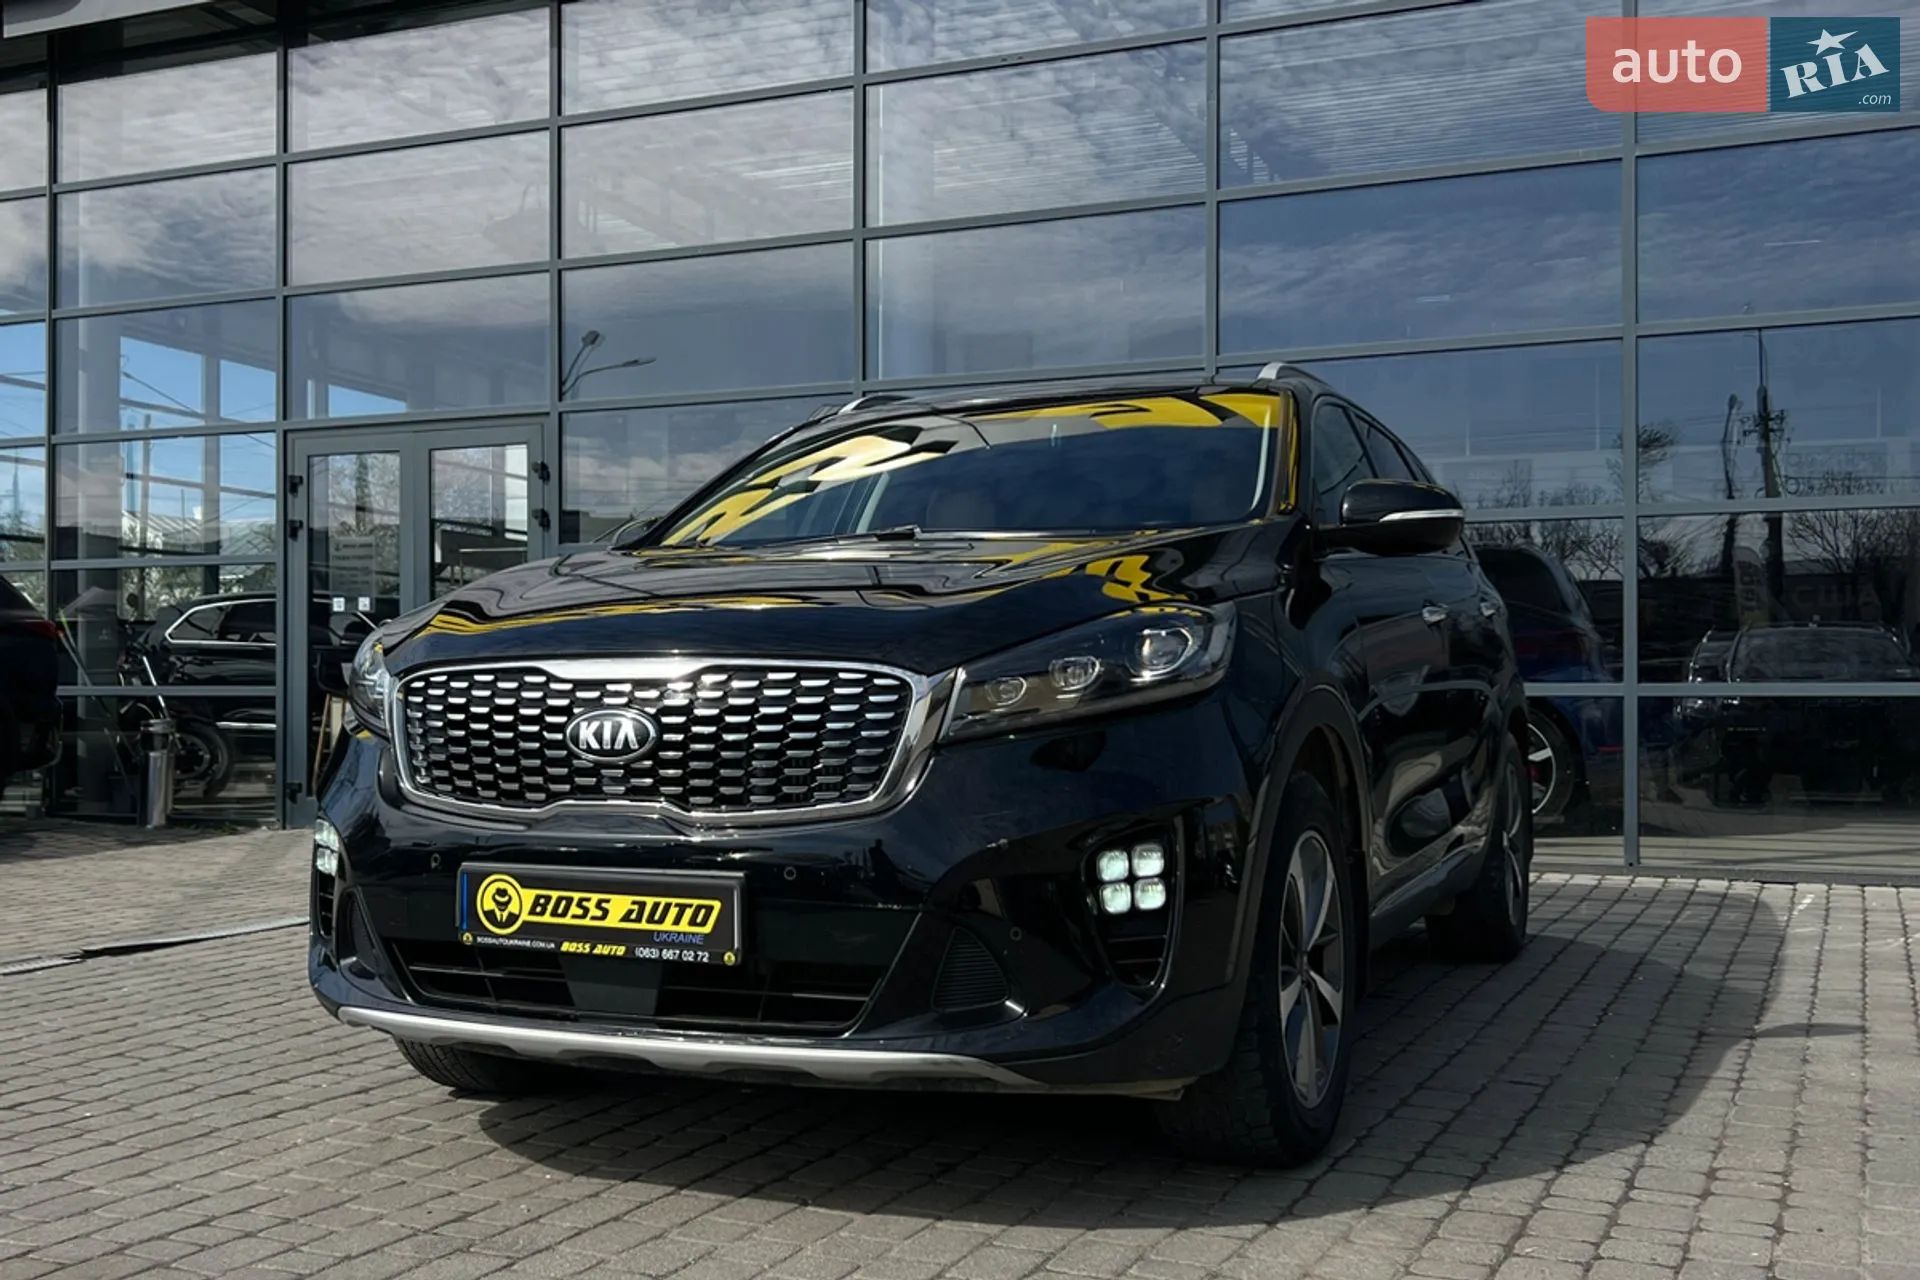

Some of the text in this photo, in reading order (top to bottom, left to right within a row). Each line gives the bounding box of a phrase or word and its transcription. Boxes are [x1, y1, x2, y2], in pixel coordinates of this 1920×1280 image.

[579, 720, 640, 750] KIA
[528, 894, 716, 928] BOSS AUTO
[653, 932, 705, 944] UKRAINE
[560, 941, 627, 956] BOSS AUTO
[681, 950, 695, 961] 02
[696, 951, 710, 963] 72
